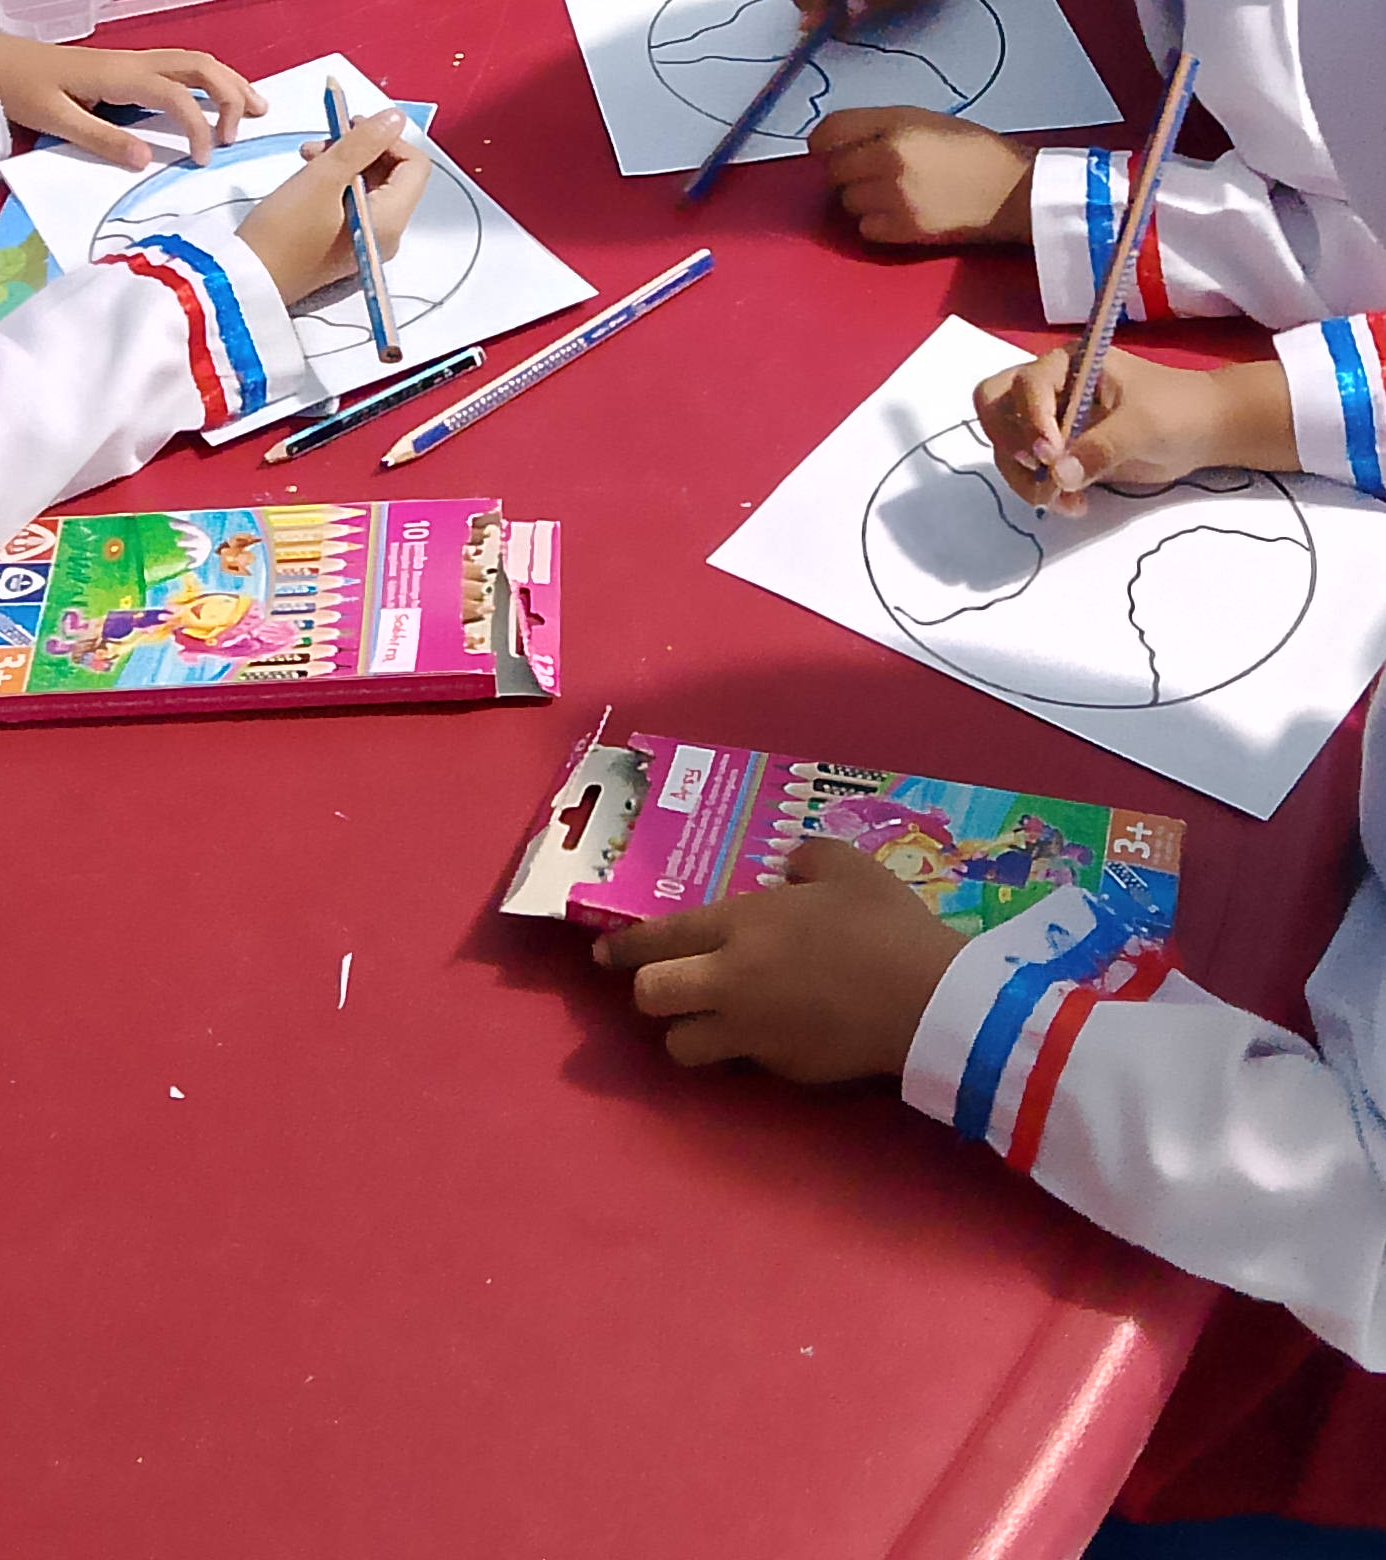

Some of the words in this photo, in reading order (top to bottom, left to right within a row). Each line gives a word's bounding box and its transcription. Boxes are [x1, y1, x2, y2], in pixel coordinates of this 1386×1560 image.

[402, 520, 430, 540] 10
[1113, 821, 1153, 860] 3+
[653, 878, 686, 900] 10
